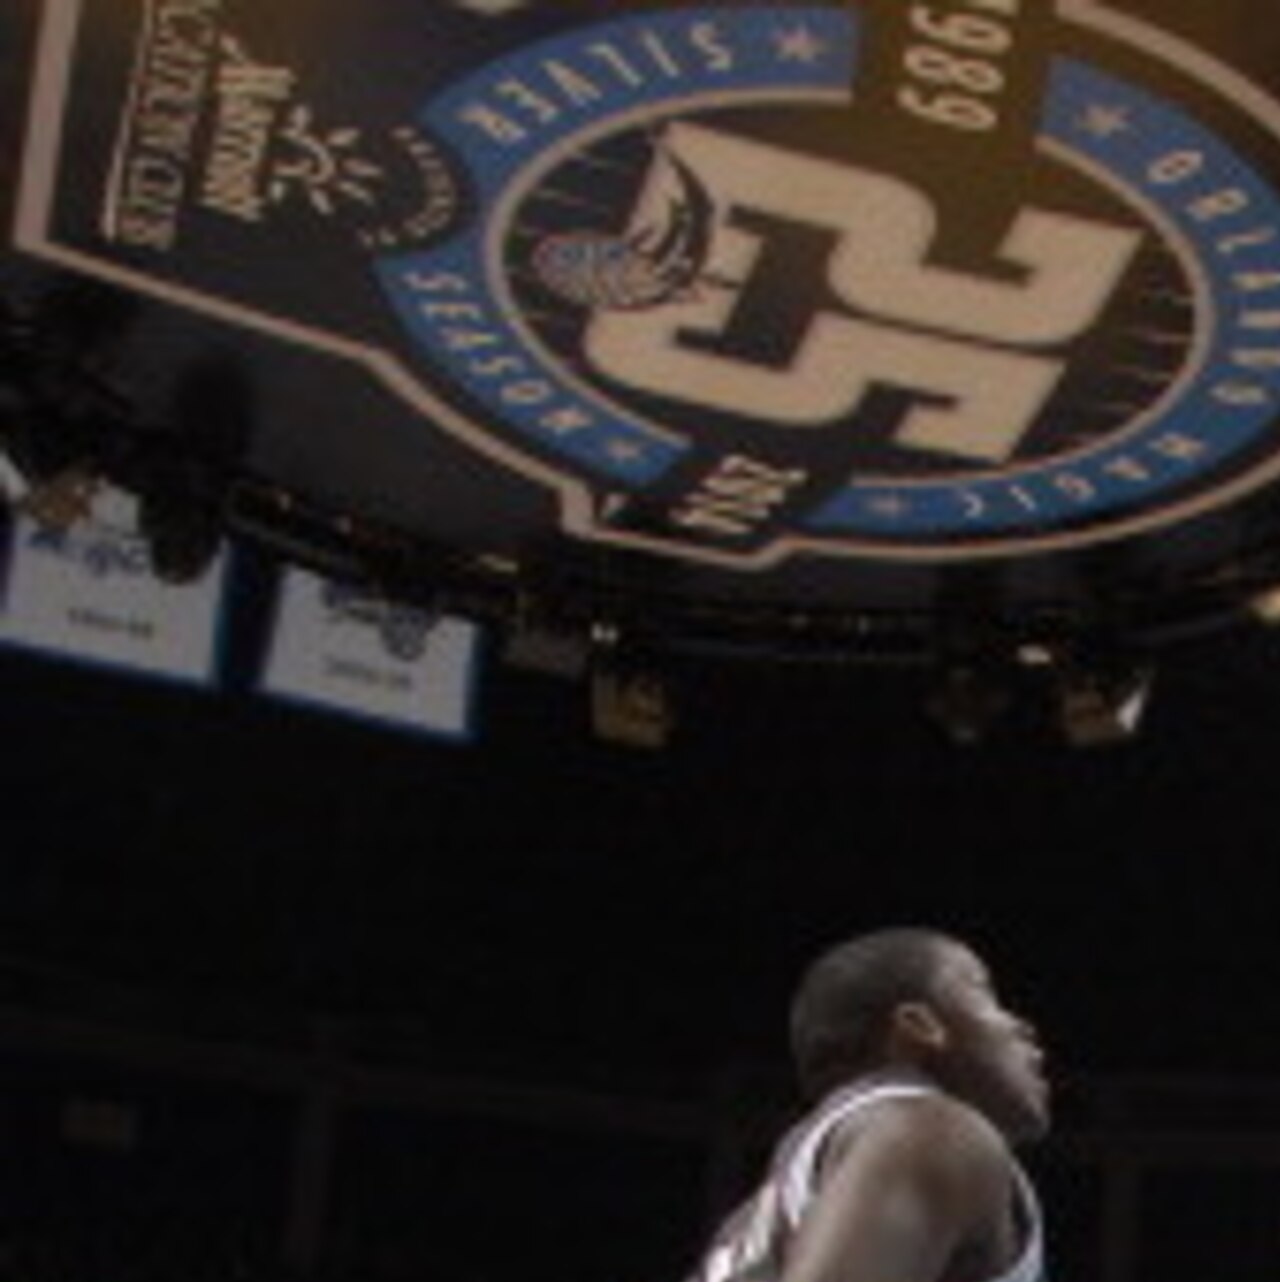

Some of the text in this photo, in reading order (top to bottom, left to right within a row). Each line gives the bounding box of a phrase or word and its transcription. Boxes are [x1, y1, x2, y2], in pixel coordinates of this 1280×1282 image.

[455, 20, 735, 145] SILVER
[400, 268, 594, 437] SEASON
[583, 118, 1146, 466] 25
[958, 430, 1208, 520] MAGIC
